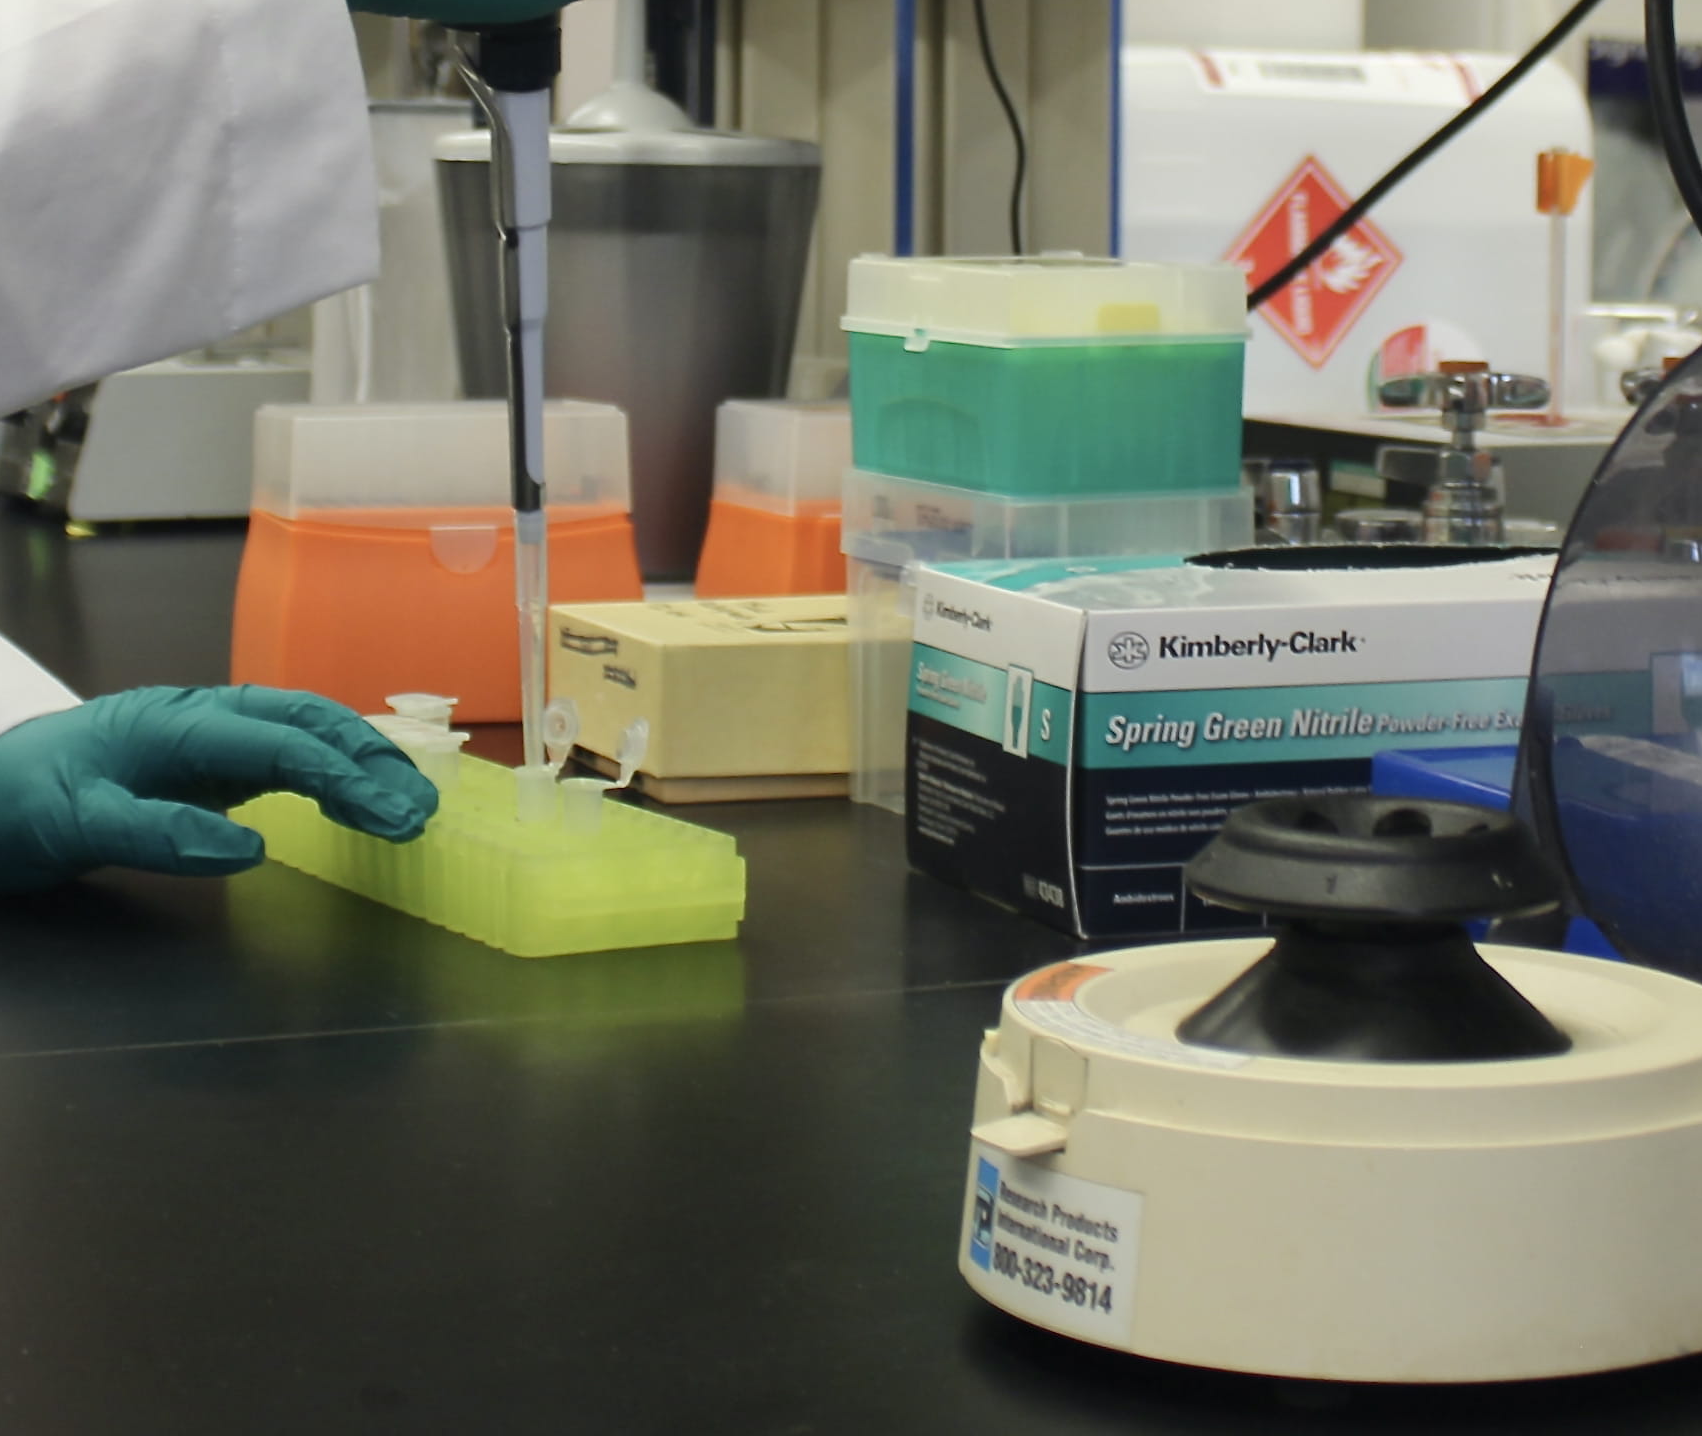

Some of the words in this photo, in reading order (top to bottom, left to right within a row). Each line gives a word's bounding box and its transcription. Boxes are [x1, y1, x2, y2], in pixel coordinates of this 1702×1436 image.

[1159, 630, 1358, 662] Kimberly-Clark
[1041, 708, 1051, 741] S
[1105, 714, 1196, 751] Spring
[1203, 712, 1283, 741] Green
[1289, 707, 1373, 737] Nitrile
[1375, 710, 1489, 734] Powder-Free
[1000, 1179, 1048, 1220] Research
[1052, 1203, 1119, 1244] Products
[998, 1209, 1071, 1257] International
[1074, 1239, 1115, 1275] Corp.
[993, 1241, 1113, 1315] 800-323-9814
